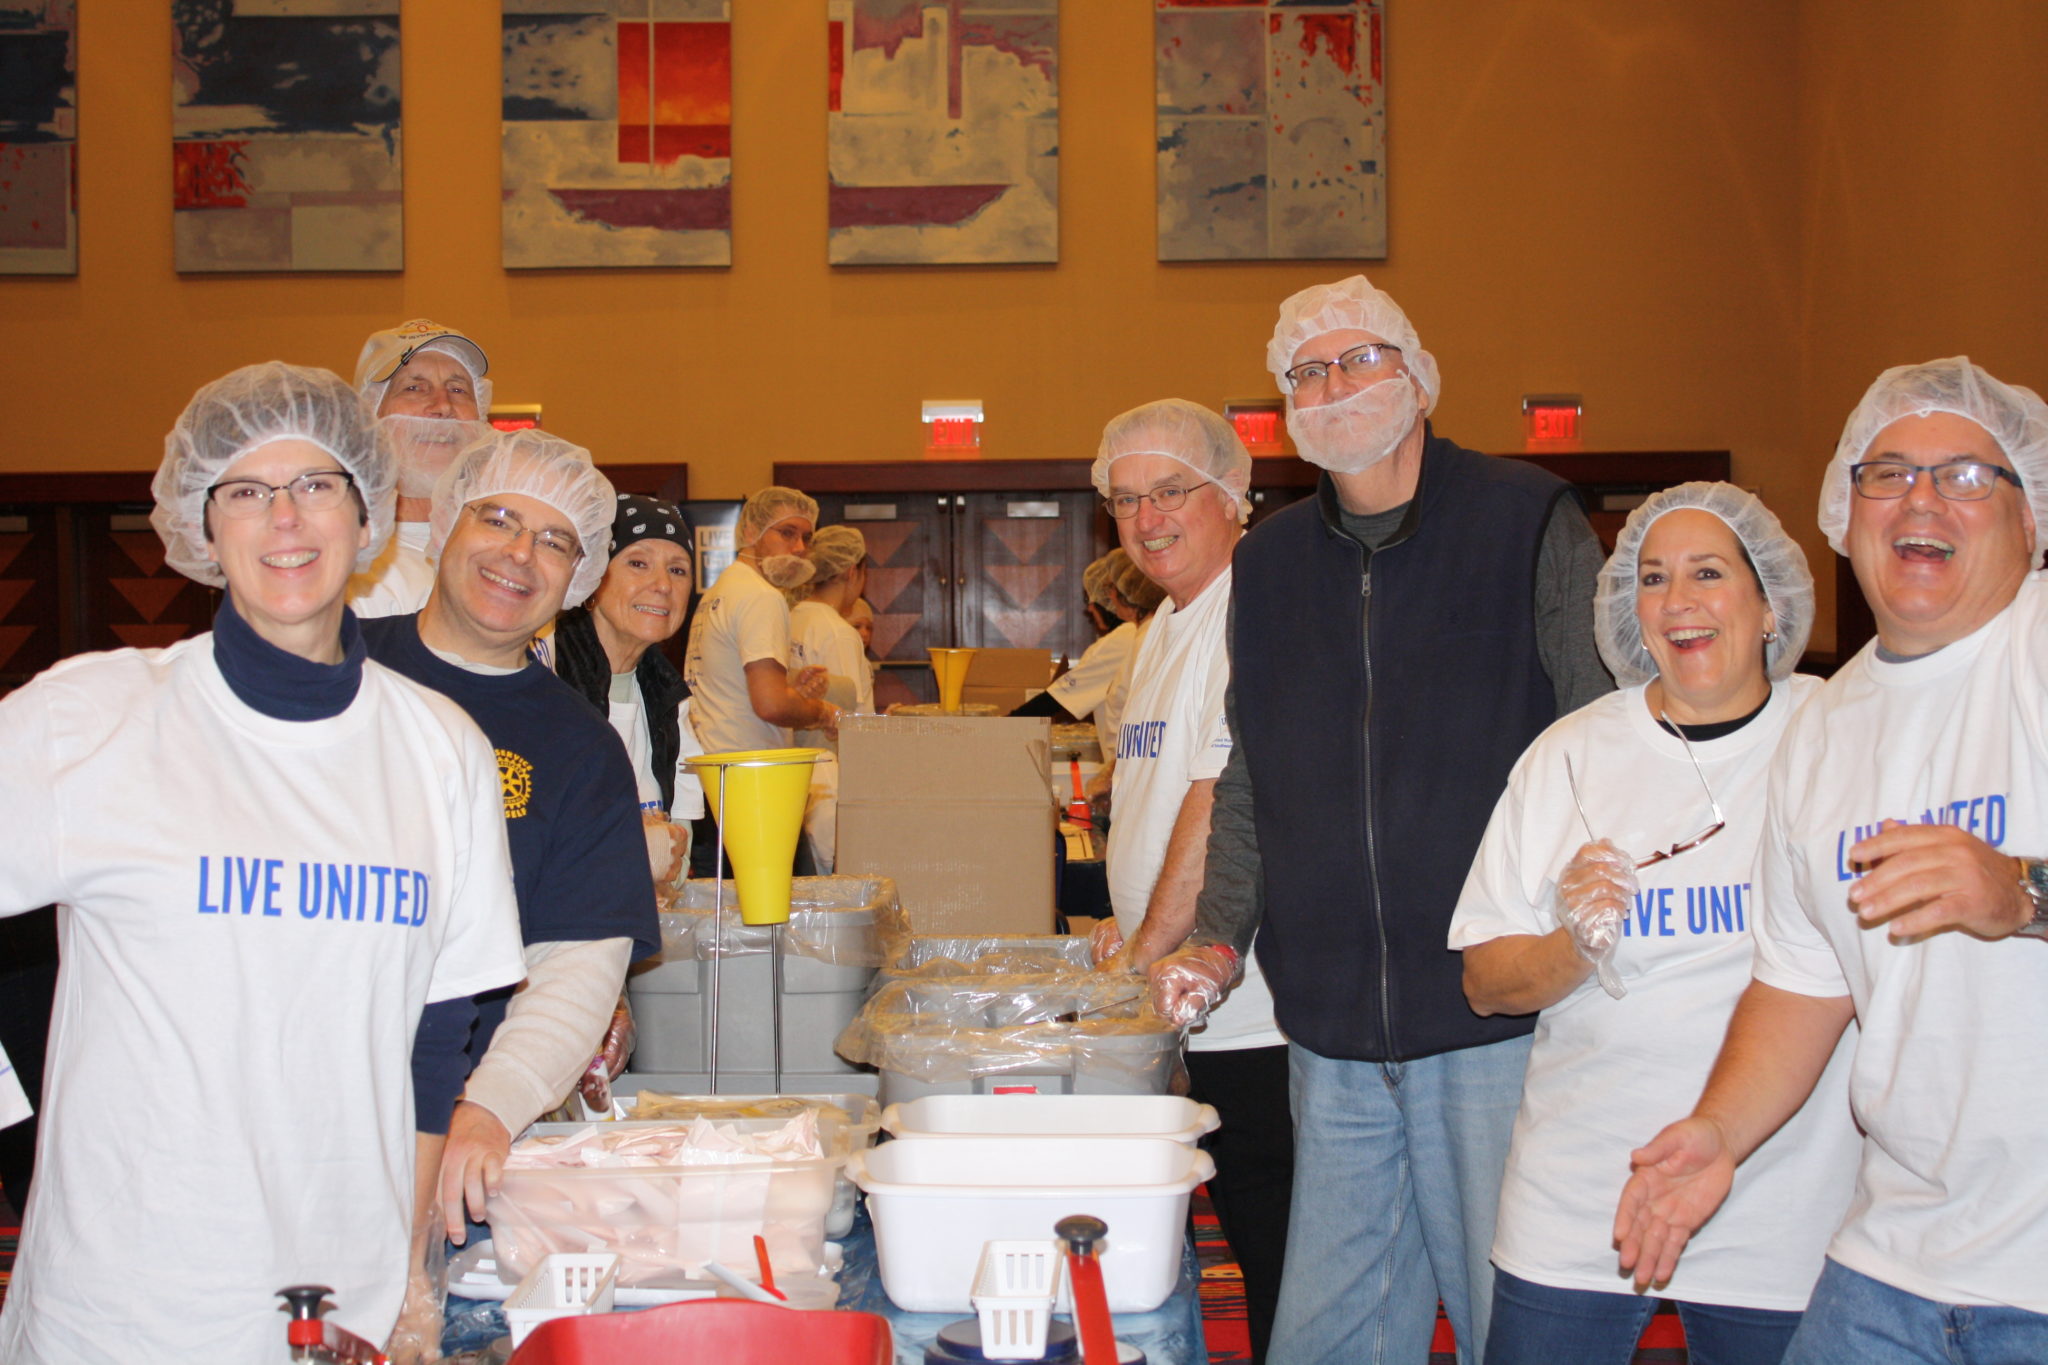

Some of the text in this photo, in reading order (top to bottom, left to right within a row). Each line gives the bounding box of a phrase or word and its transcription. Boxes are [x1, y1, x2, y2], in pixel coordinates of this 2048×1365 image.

[934, 417, 973, 446] EXIT
[1234, 412, 1277, 443] EXIT
[1535, 408, 1577, 439] EXIT
[198, 856, 429, 927] LIVE UNITED
[1622, 888, 1676, 937] IVE
